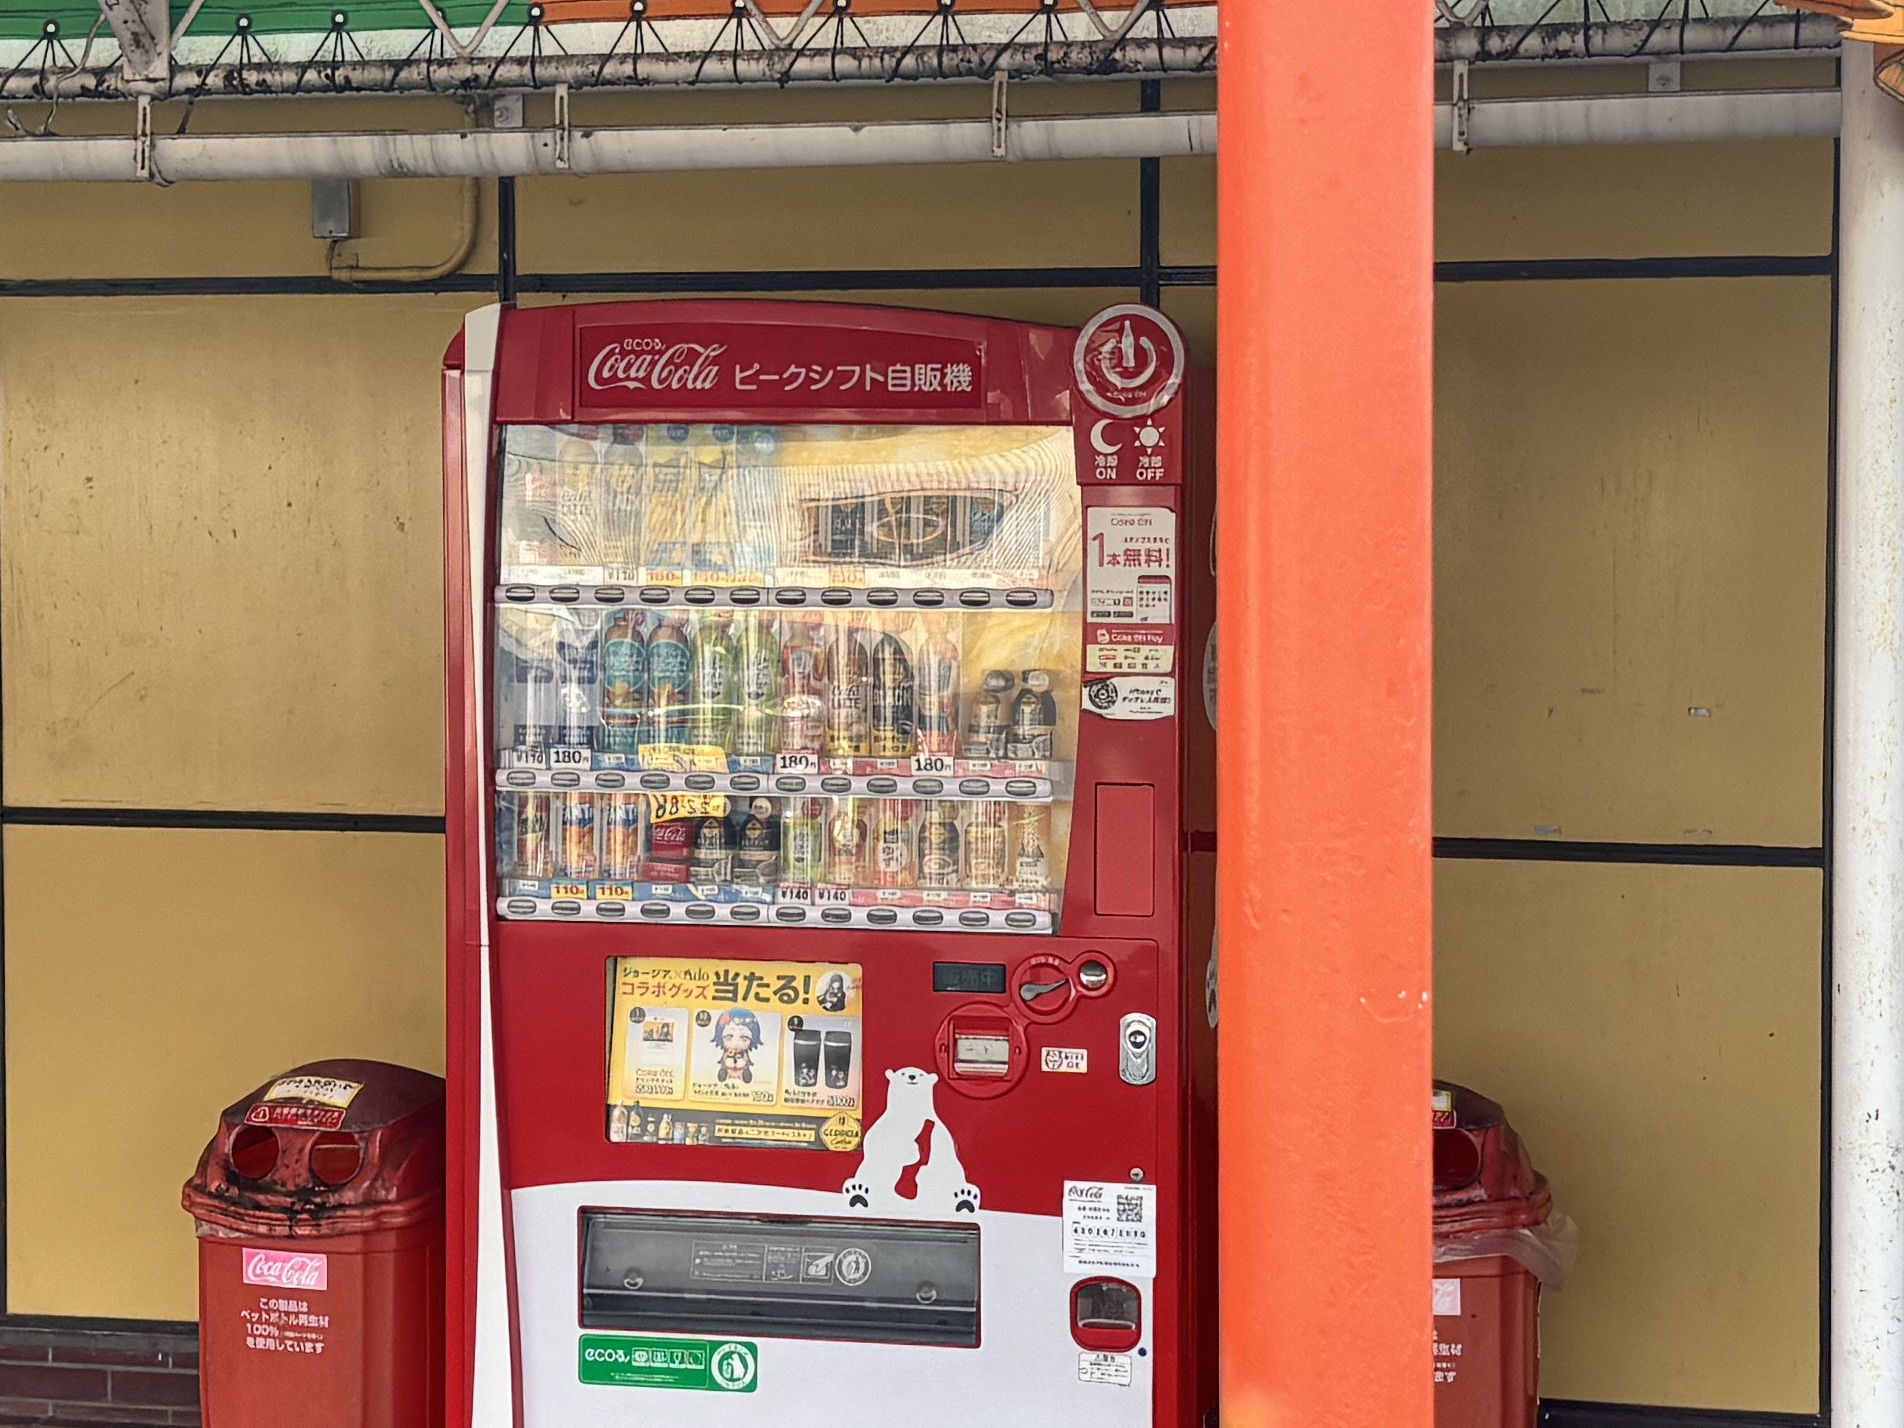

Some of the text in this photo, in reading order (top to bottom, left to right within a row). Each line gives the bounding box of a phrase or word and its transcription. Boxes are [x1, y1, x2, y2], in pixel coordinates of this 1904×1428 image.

[588, 343, 728, 391] Coca-Cola
[734, 363, 973, 393] ピークシフト自販機
[1096, 468, 1116, 479] ON
[1136, 468, 1164, 480] OFF
[621, 982, 711, 1000] コラボグッズ
[711, 970, 812, 1006] 当たる!
[247, 1253, 321, 1285] Coca-Cola
[259, 1297, 308, 1312] この製品は
[241, 1309, 329, 1328] ペットボトル再生材
[246, 1323, 279, 1337] 100%
[246, 1336, 325, 1354] を使用しています
